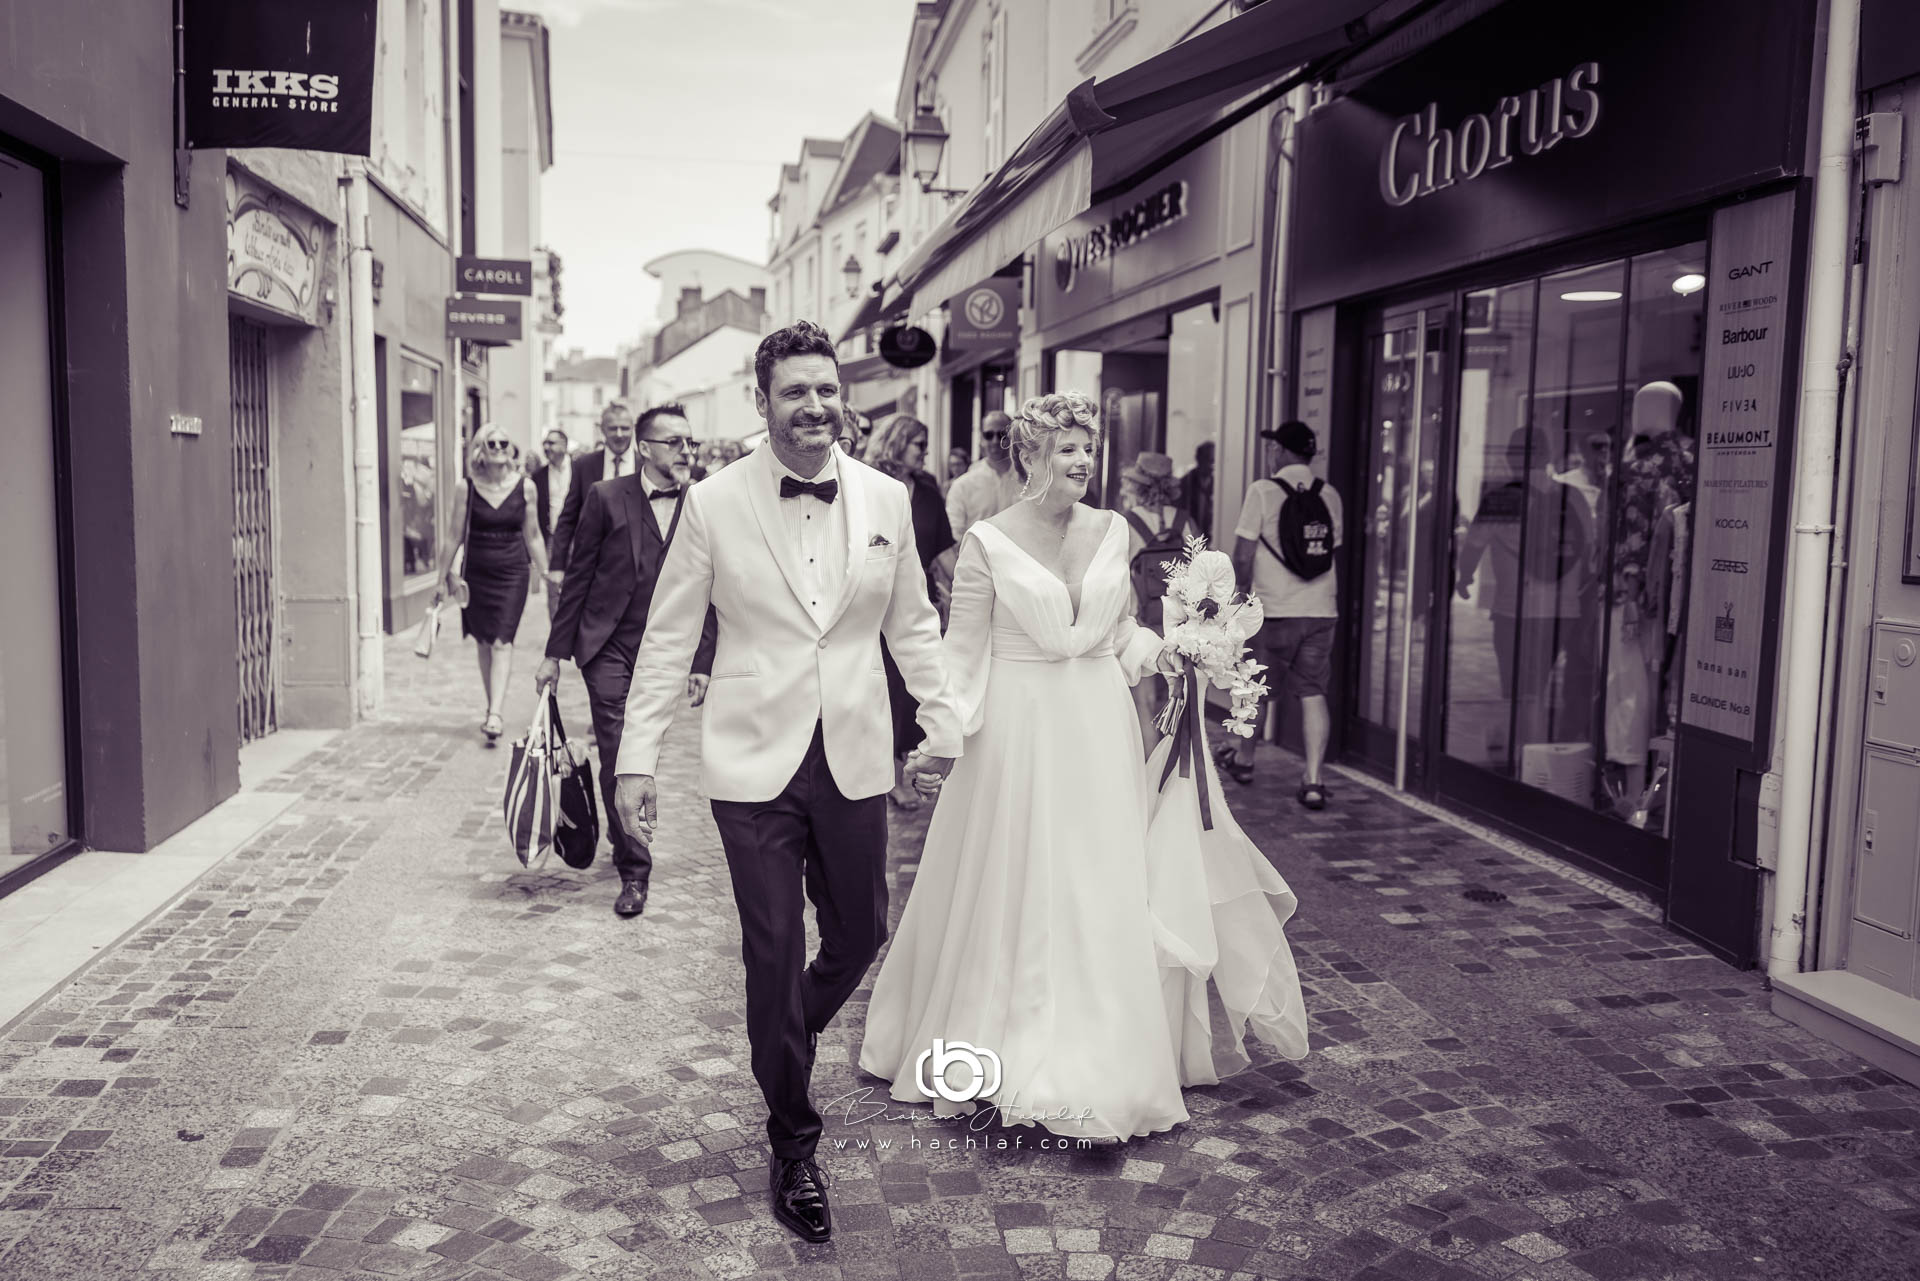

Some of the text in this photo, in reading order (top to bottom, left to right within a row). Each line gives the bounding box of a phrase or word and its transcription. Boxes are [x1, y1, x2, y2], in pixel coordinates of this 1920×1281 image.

[212, 69, 339, 99] IKKS
[212, 97, 338, 113] GENERAL STORE
[1380, 62, 1599, 206] Chorus
[1072, 180, 1188, 271] YVES ROCHER
[464, 268, 523, 285] CAROLL
[1728, 261, 1773, 280] GANT
[1722, 327, 1768, 345] Barbour
[1706, 430, 1770, 444] BEAUMONT
[1715, 518, 1749, 530] KOCCA
[1697, 660, 1747, 679] hana san
[1690, 693, 1727, 710] BLONDE
